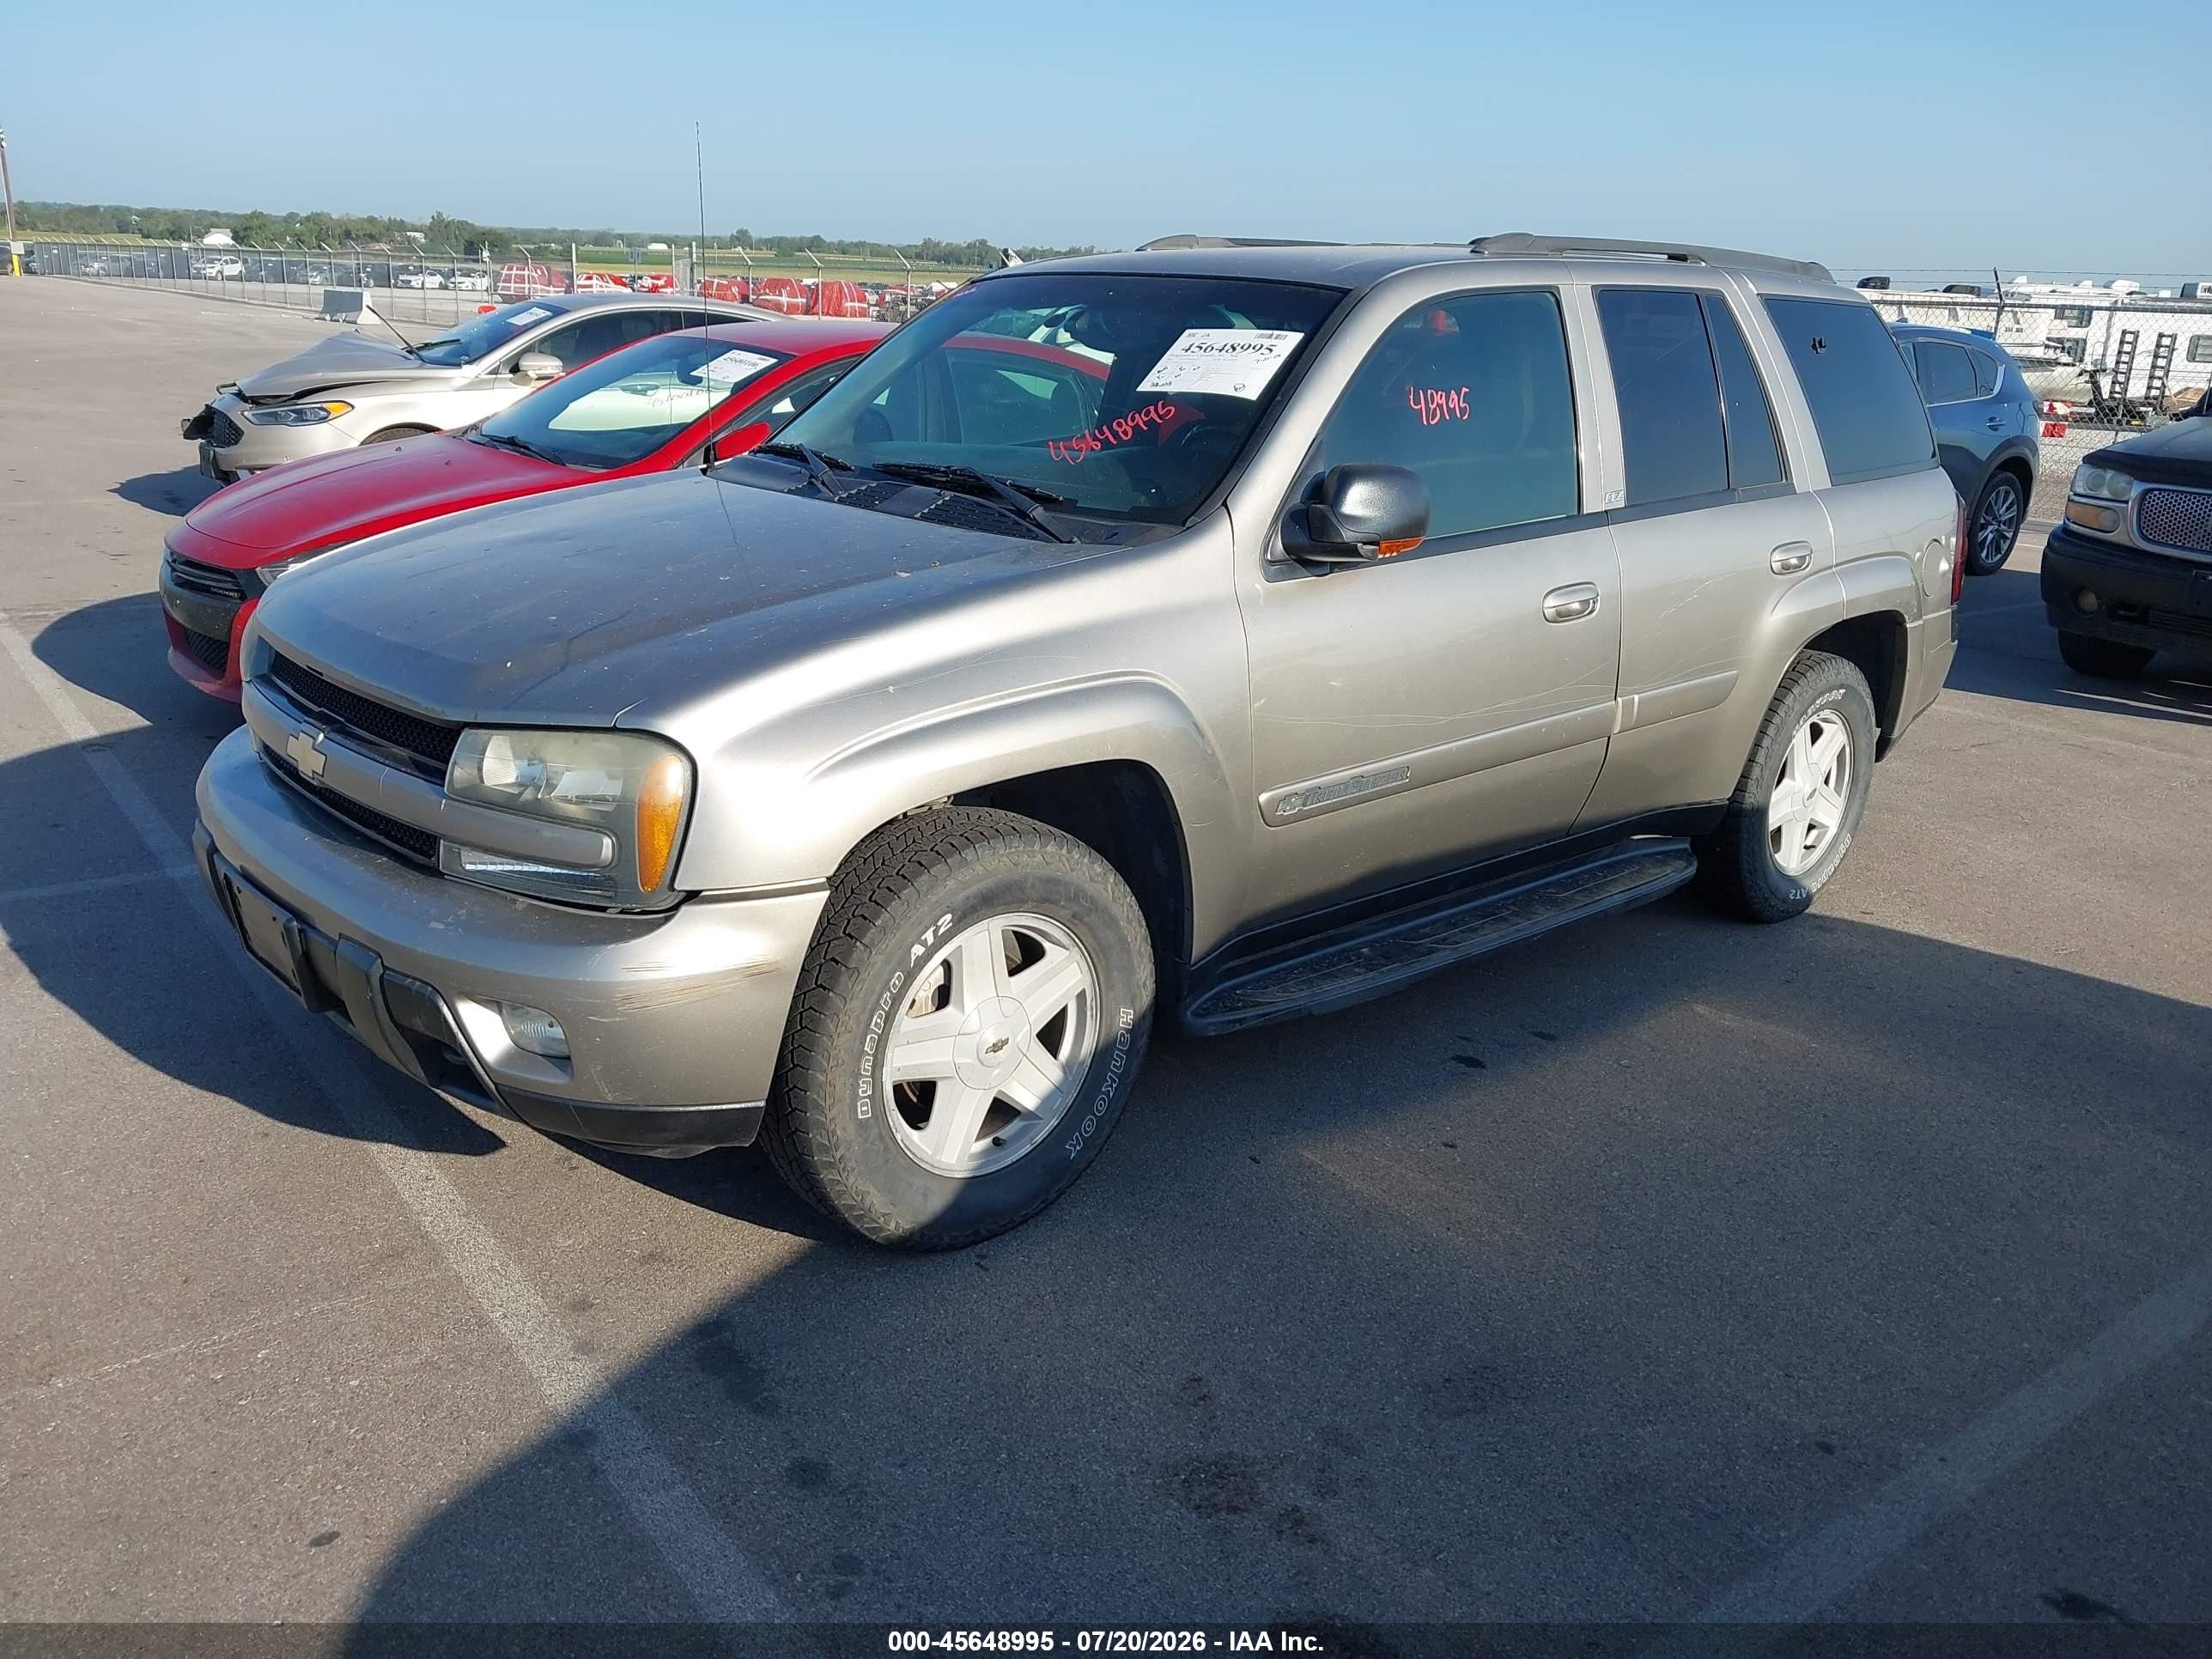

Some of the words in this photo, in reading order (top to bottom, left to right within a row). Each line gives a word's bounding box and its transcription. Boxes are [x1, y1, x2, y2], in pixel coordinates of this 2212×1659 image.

[1182, 342, 1277, 356] 45648995
[1408, 386, 1470, 425] 48995
[1048, 400, 1176, 465] 45648995
[910, 913, 953, 968] AT2
